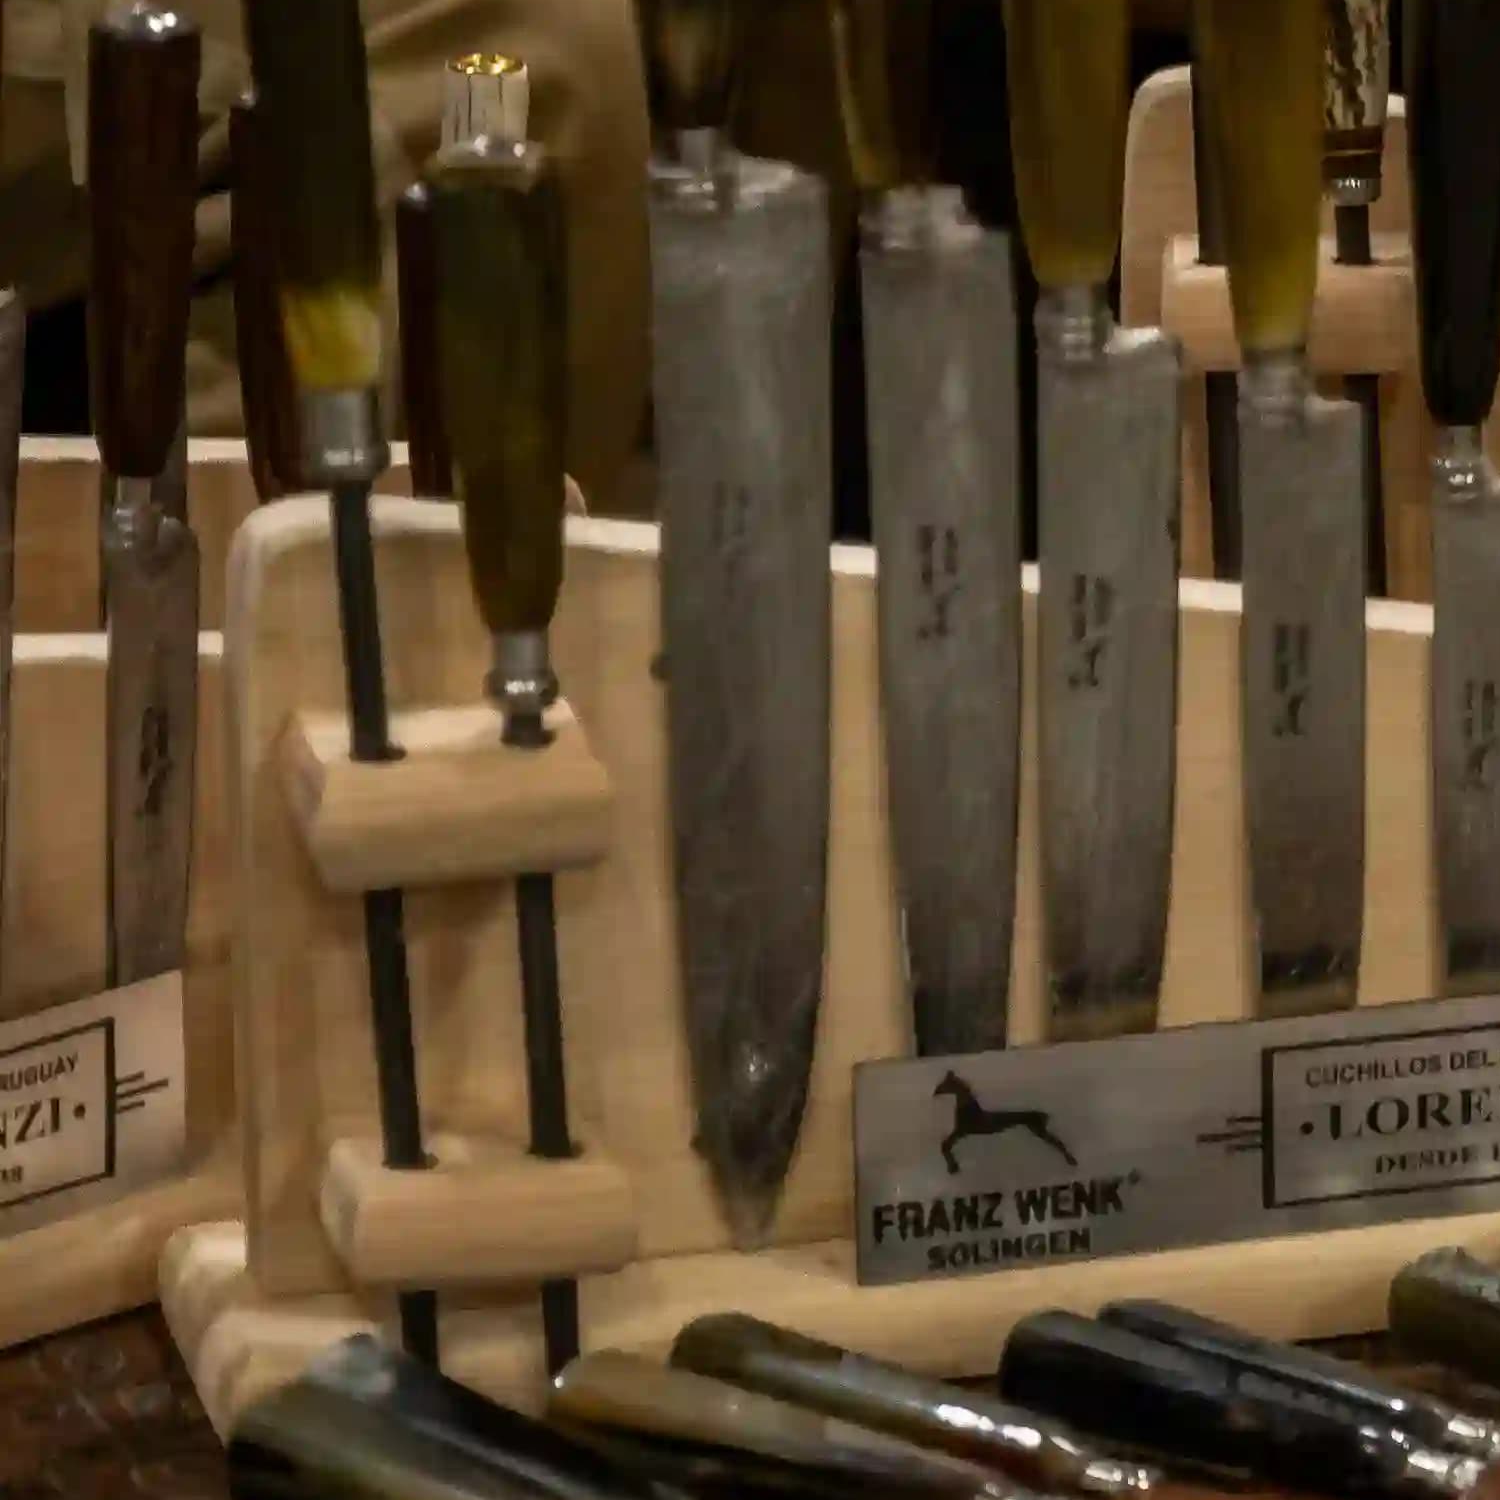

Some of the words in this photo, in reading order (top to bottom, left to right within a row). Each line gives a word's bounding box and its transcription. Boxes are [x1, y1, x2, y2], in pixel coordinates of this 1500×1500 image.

[1304, 1056, 1442, 1089] CUCHILLOS
[1449, 1048, 1495, 1071] DEL
[1374, 1143, 1479, 1174] DESDE
[873, 1192, 1004, 1244] FRANZ
[926, 1228, 1092, 1271] SOLINGEN
